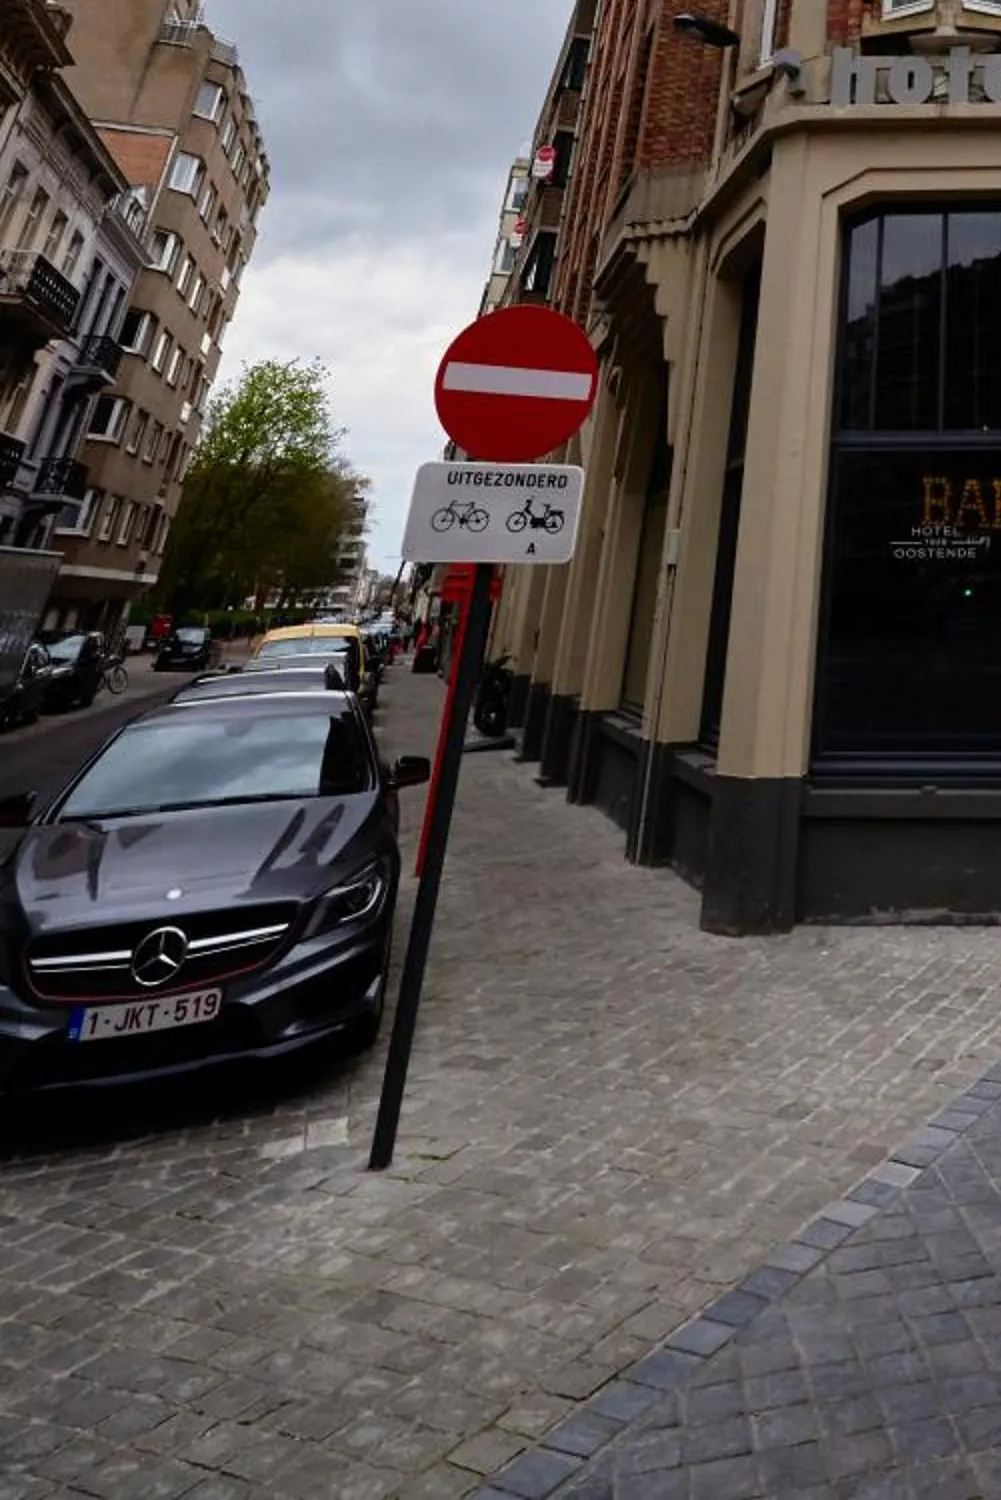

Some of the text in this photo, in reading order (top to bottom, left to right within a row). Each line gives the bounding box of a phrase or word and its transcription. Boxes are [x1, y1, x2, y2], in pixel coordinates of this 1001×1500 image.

[448, 471, 568, 489] UITGEZONDERD
[911, 526, 960, 538] HOTEL
[526, 542, 536, 554] A
[894, 548, 977, 559] OOSTENDE
